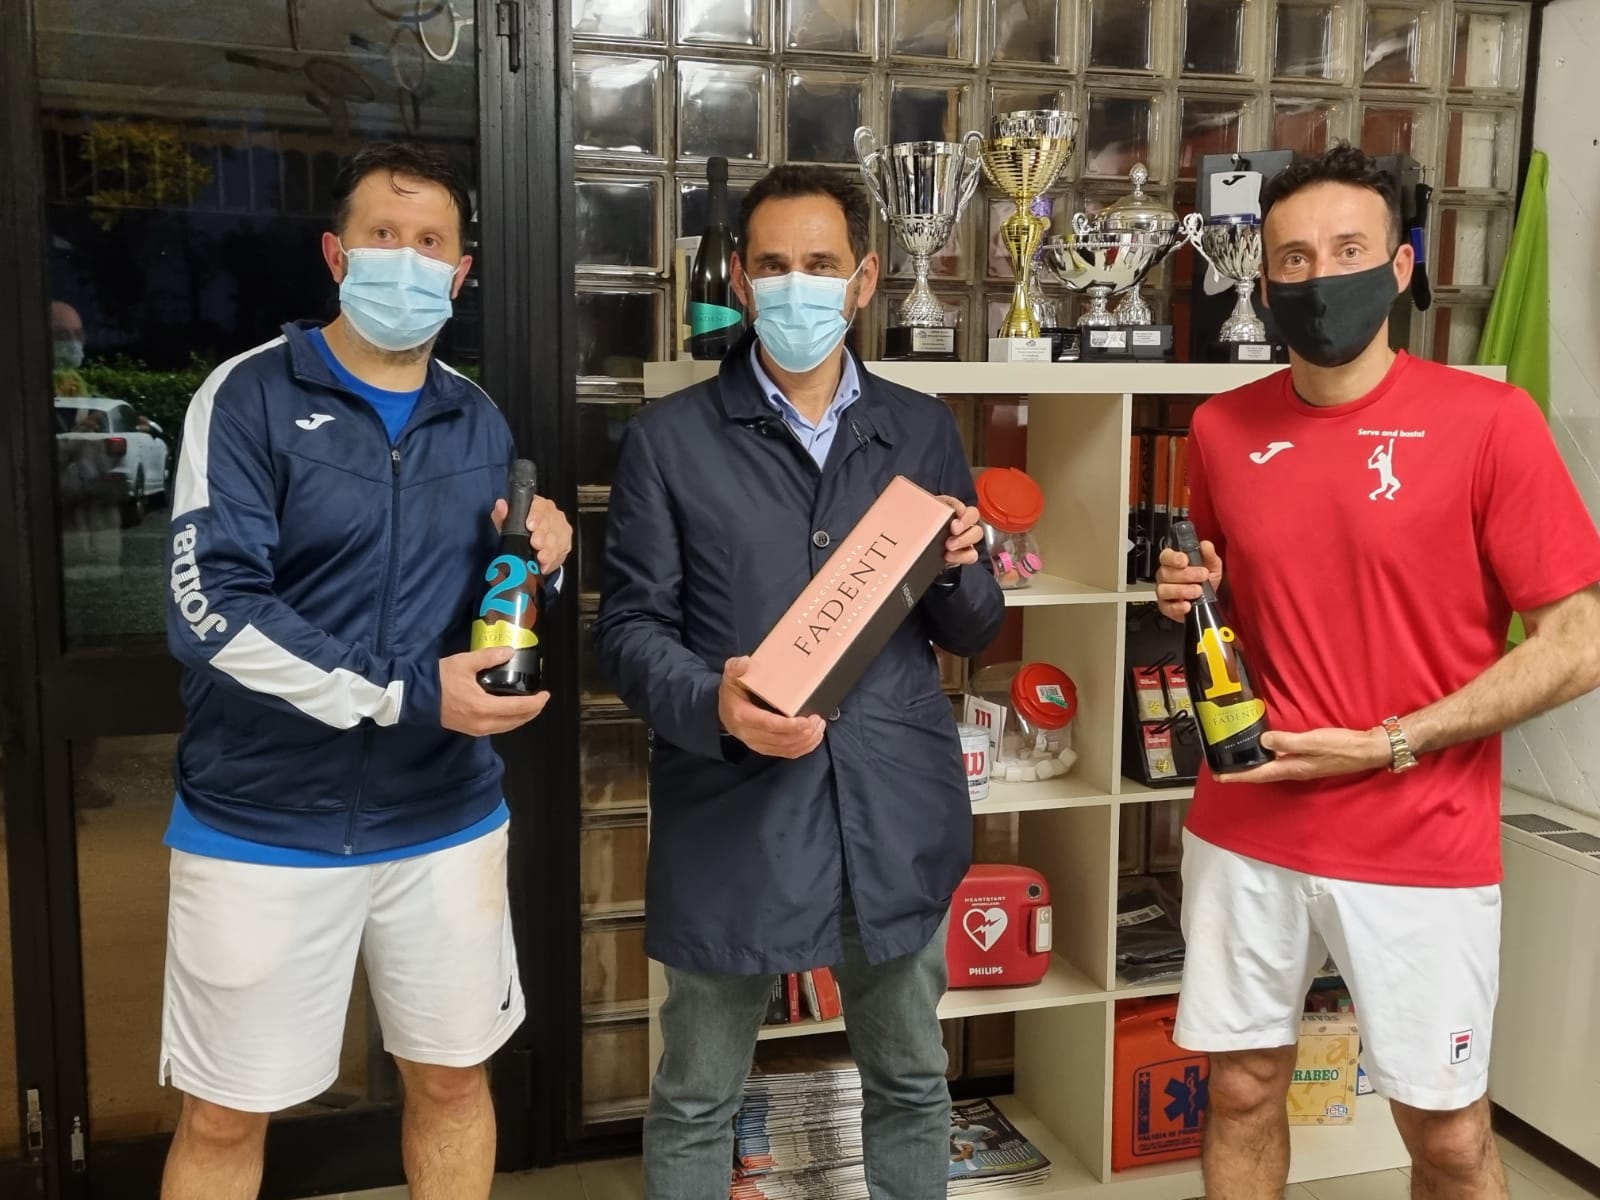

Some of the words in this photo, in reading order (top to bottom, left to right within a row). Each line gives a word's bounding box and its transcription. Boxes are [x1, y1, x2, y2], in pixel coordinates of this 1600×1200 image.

[1358, 428, 1380, 437] Serve
[1381, 429, 1399, 437] and
[793, 532, 898, 657] FADENTI
[964, 895, 1006, 904] HEARTSTART
[969, 966, 1004, 976] PHILIPS
[1292, 1069, 1340, 1081] RABEO
